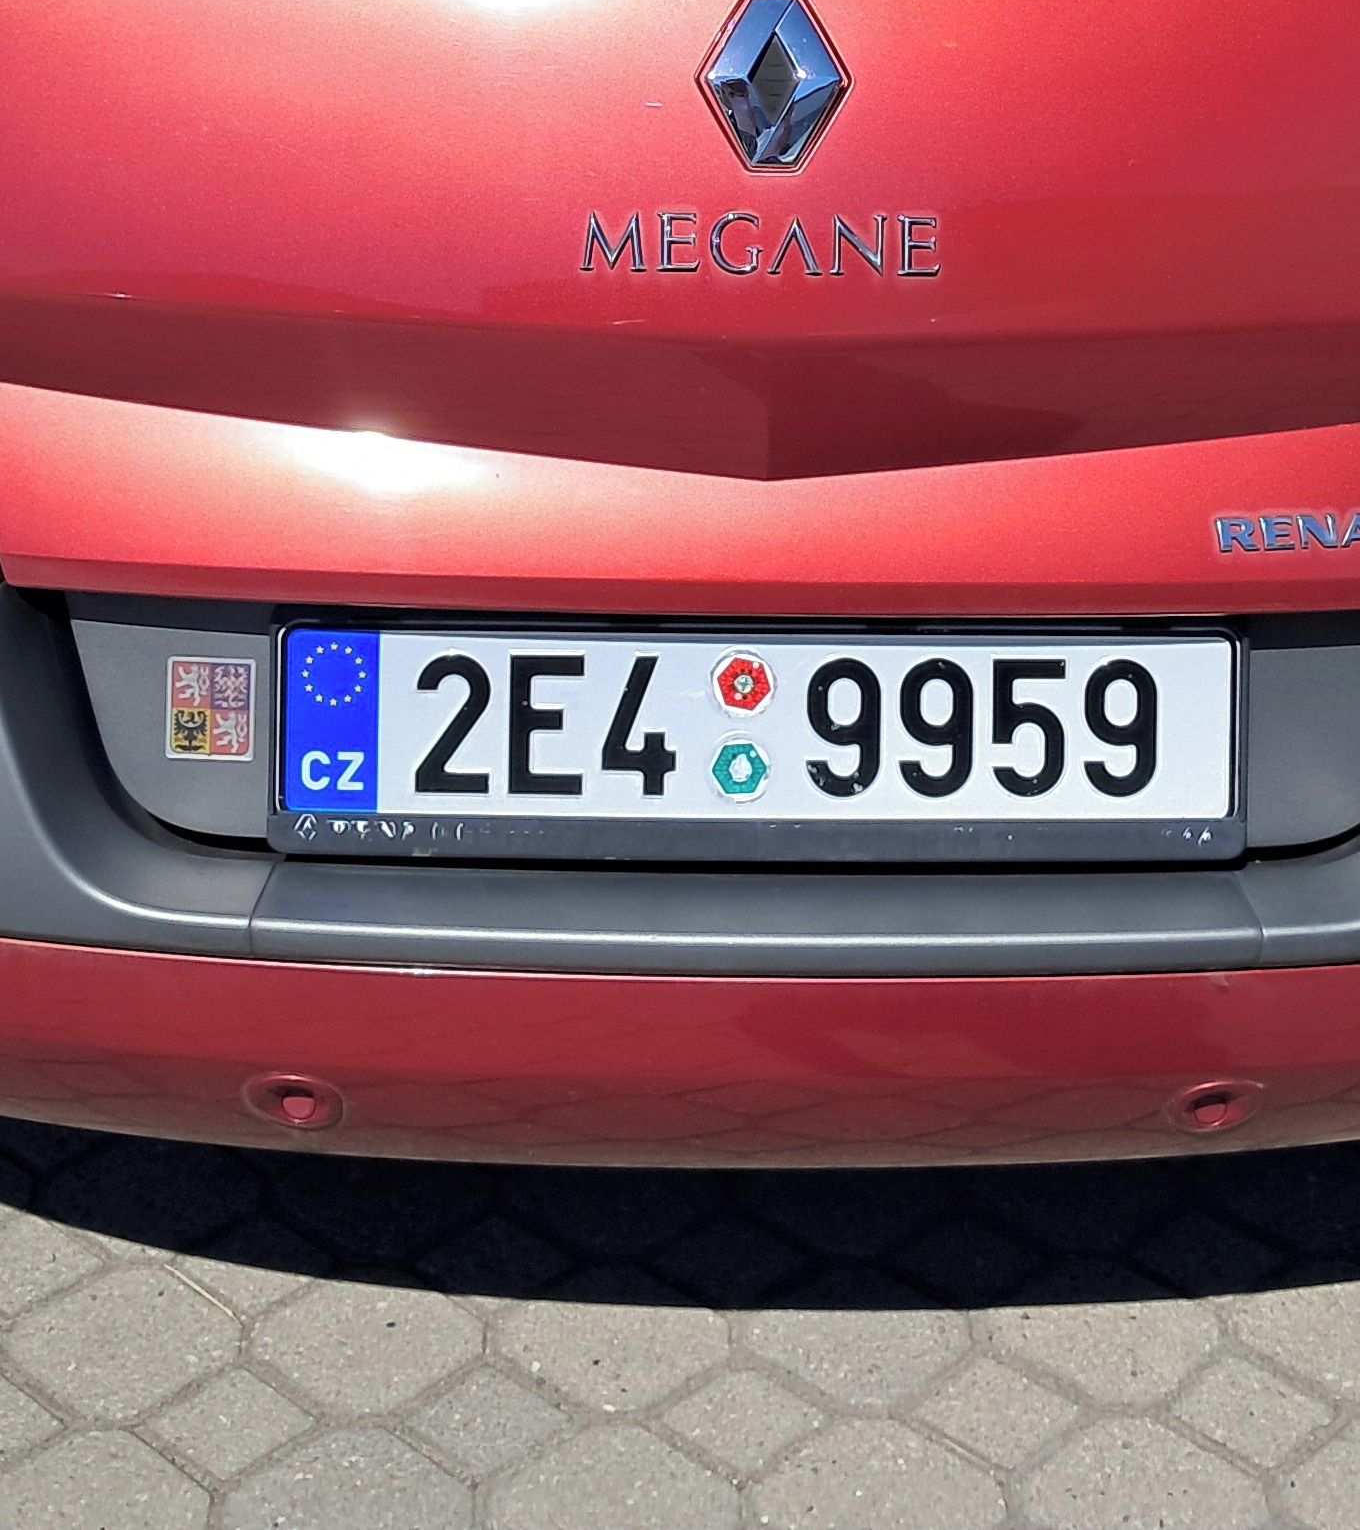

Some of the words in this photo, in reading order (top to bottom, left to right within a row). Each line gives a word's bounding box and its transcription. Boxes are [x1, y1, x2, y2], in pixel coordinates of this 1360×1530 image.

[579, 210, 941, 277] MEGANE
[414, 652, 678, 797] 2E4
[805, 657, 1159, 799] 9959
[301, 750, 365, 791] CZ
